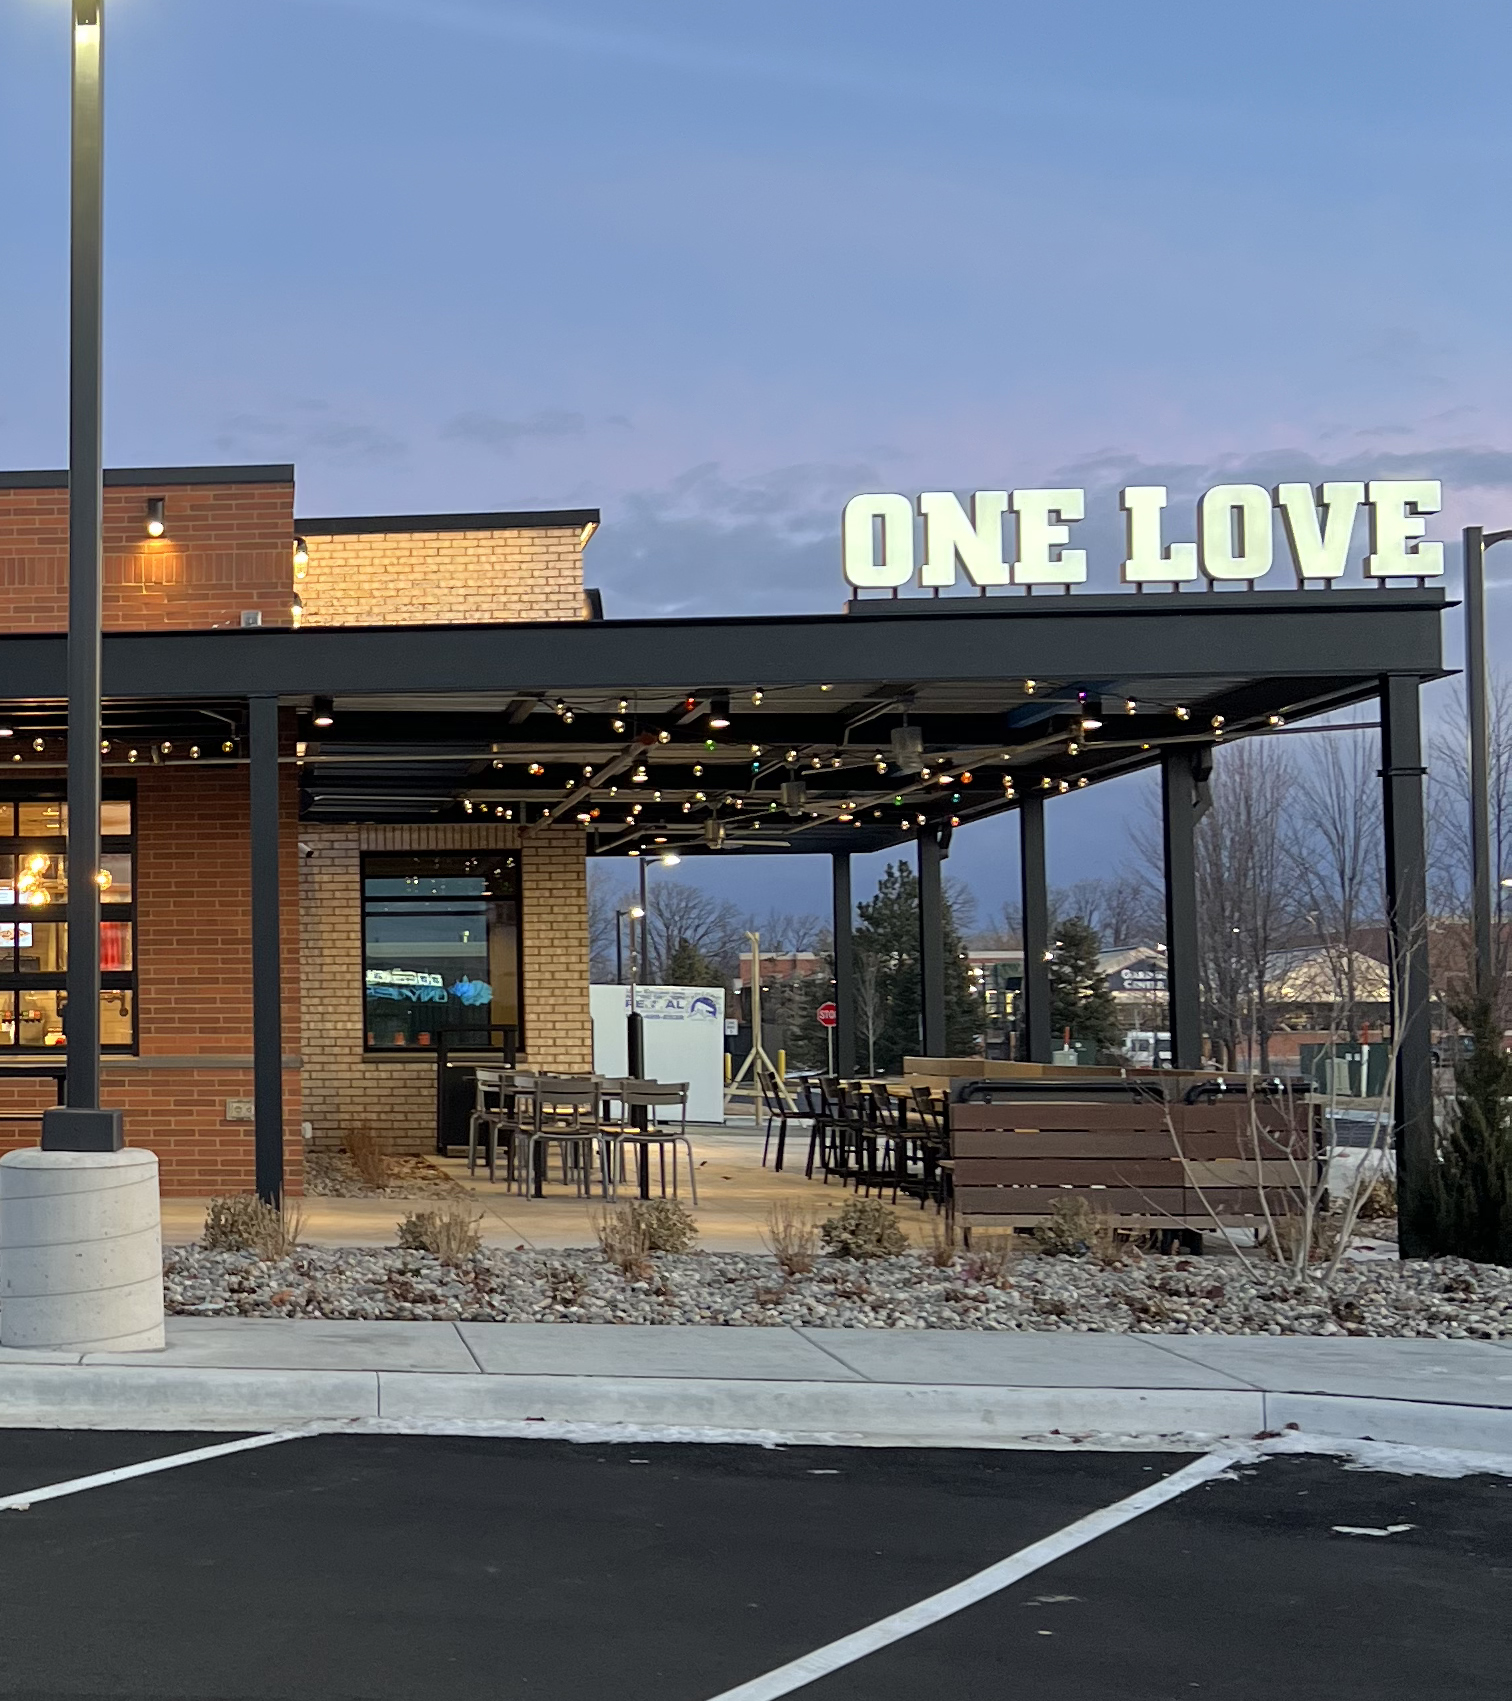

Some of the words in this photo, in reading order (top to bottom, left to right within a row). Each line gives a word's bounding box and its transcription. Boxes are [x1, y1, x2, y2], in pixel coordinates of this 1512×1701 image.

[842, 487, 1088, 588] ONE
[1119, 480, 1446, 581] LOVE
[819, 1009, 836, 1020] STO
